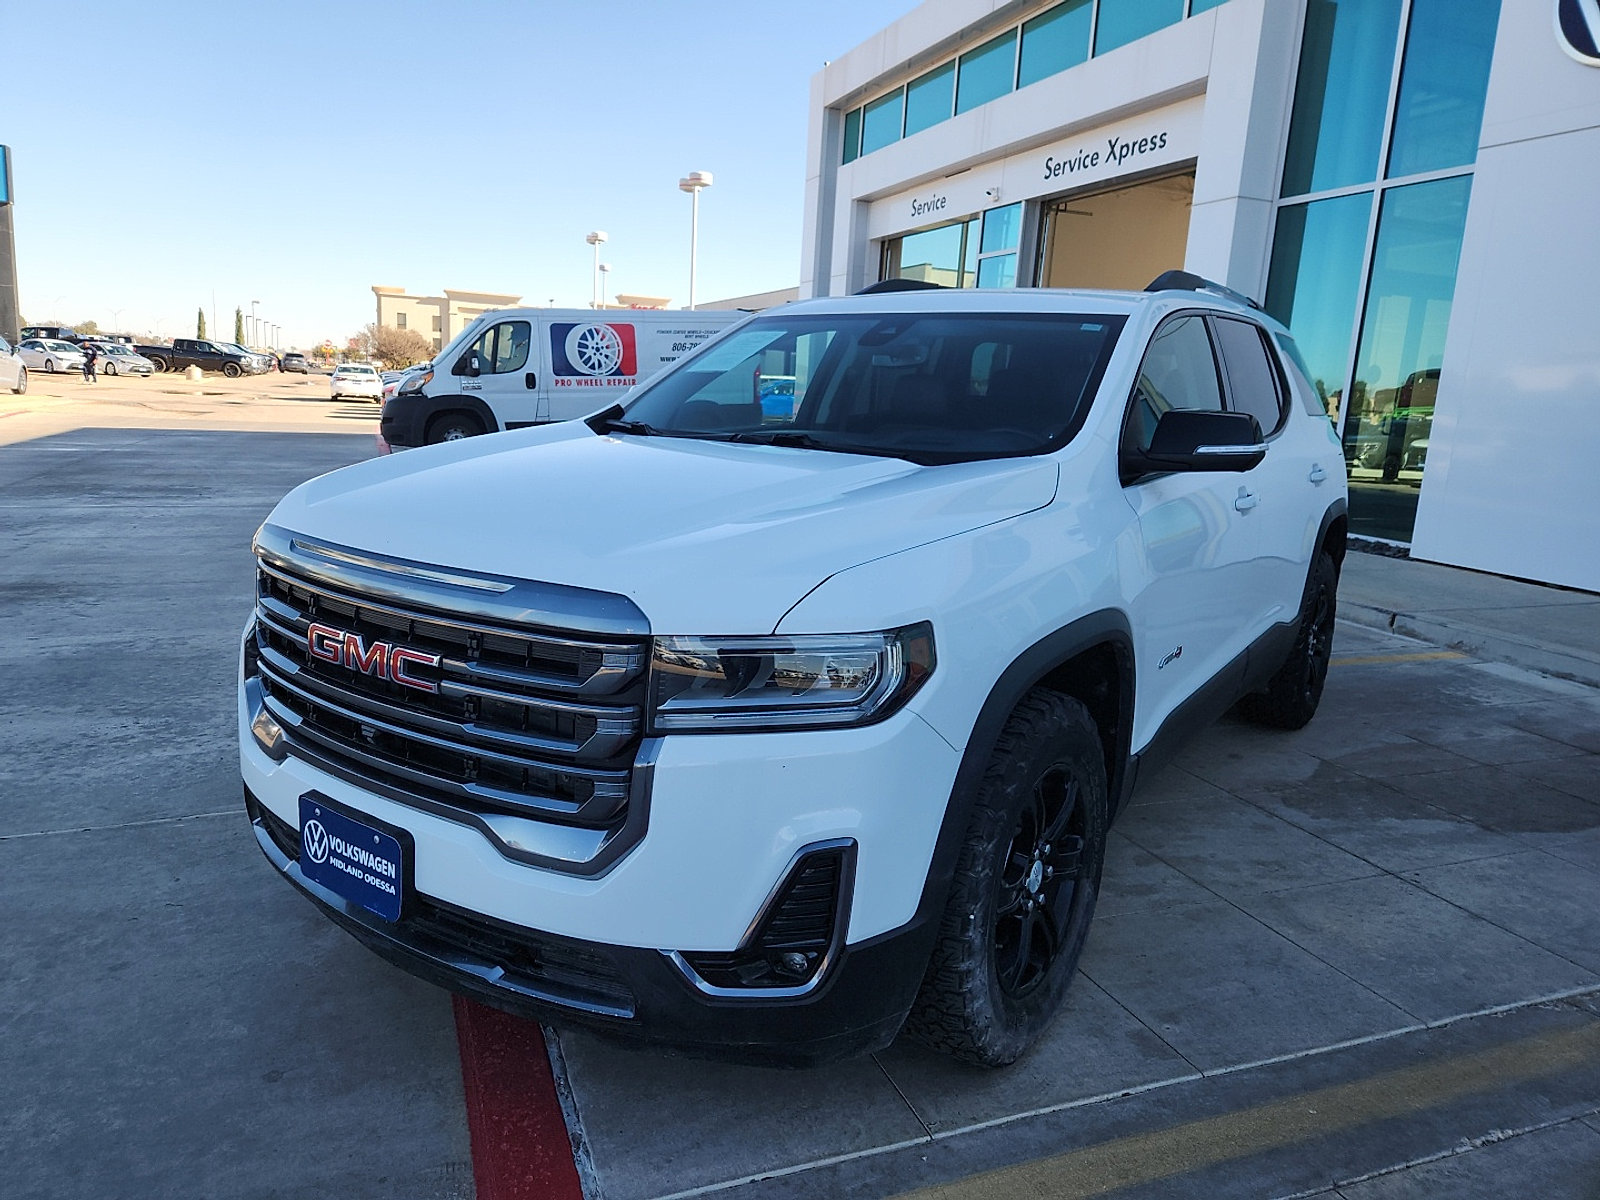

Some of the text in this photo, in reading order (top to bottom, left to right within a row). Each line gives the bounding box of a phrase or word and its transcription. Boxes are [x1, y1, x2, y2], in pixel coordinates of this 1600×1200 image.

[1043, 131, 1168, 180] Service Xpress
[911, 193, 947, 217] Service
[554, 378, 637, 387] PRO WHEEL REPAIR
[308, 622, 440, 695] GMC
[328, 834, 396, 879] VOLKSWAGEN
[329, 855, 396, 896] MIDLAND ODESSA
